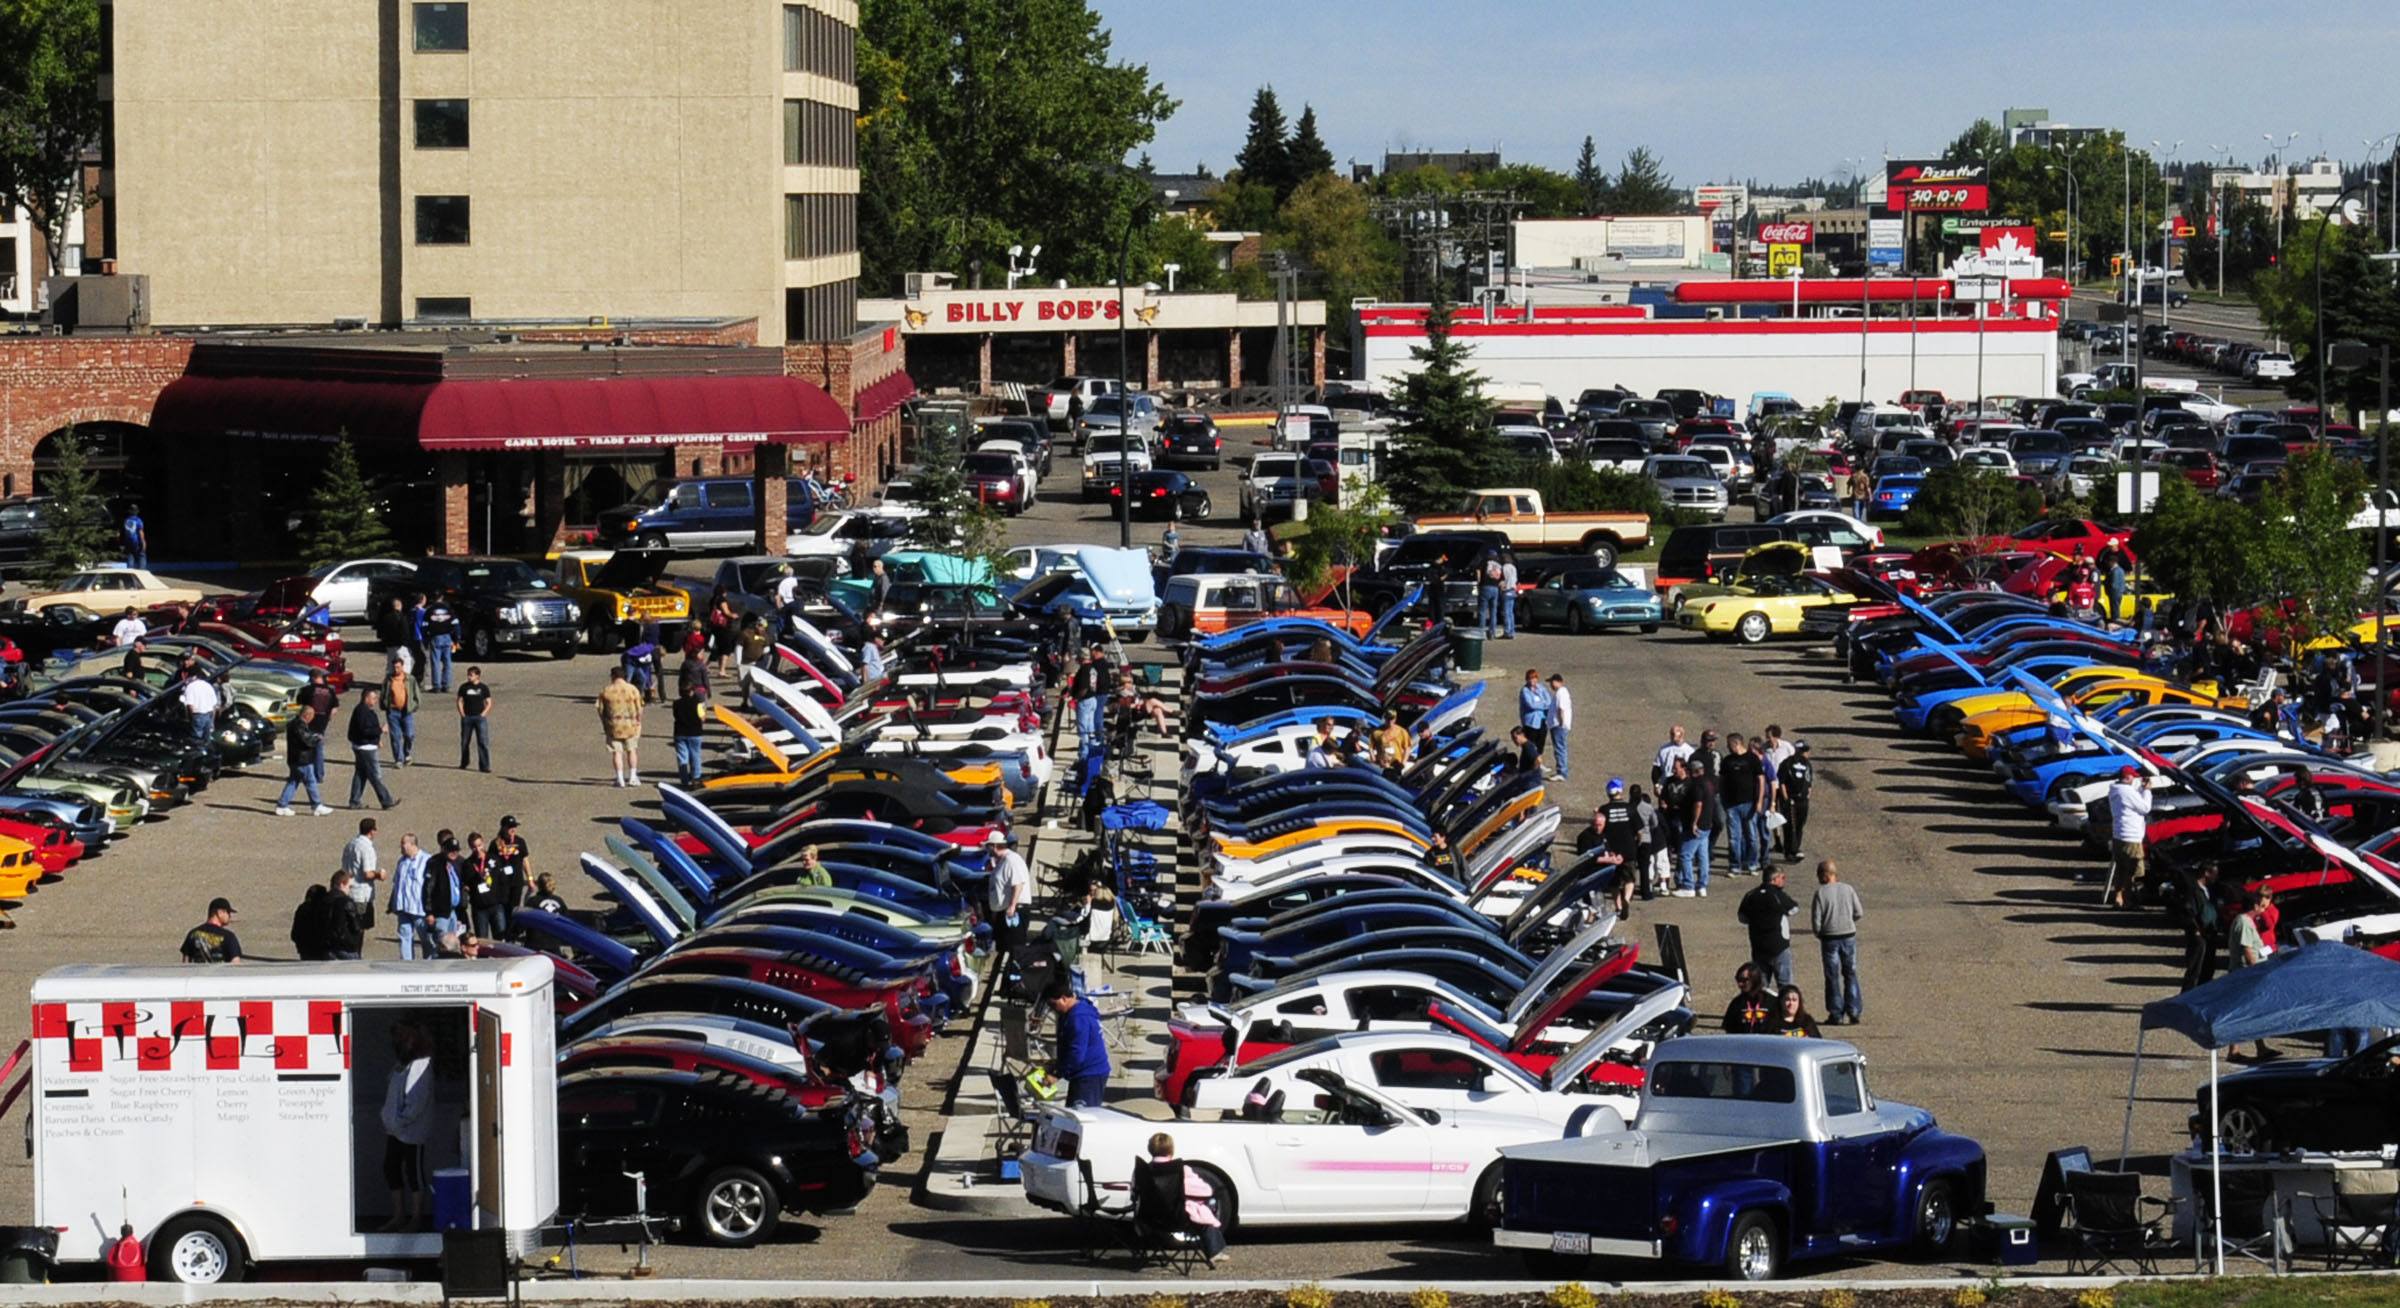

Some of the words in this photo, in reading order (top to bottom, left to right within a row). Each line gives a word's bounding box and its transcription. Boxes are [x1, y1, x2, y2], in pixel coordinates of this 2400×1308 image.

[1959, 218, 2021, 227] Enterprise
[947, 302, 1024, 322] BILLY
[1038, 300, 1121, 321] BOB'S
[504, 439, 539, 447] CAPRI
[542, 438, 577, 446] HOTEL
[589, 436, 625, 446] TRADE
[628, 436, 652, 445] AND
[655, 434, 723, 444] CONVENTION
[727, 433, 768, 443] CENTRE
[44, 1076, 100, 1086] Watermelon
[109, 1074, 137, 1085] Sugar
[139, 1074, 159, 1083] Free
[160, 1073, 211, 1084] Strawberry
[238, 1073, 271, 1083] Colada
[109, 1087, 137, 1098] Sugar
[139, 1087, 159, 1096] Free
[160, 1086, 192, 1097] Cherry
[216, 1087, 249, 1097] Lemon
[278, 1087, 307, 1096] Green
[309, 1086, 337, 1097] Apple
[110, 1101, 131, 1110] Blue
[133, 1100, 179, 1111] Raspberry
[216, 1099, 248, 1110] Cherry
[278, 1098, 325, 1109] Pineapple
[110, 1114, 143, 1123] Cotton
[143, 1113, 174, 1124] Candy
[216, 1112, 250, 1123] Mango
[278, 1111, 330, 1122] Strawberry
[45, 1128, 81, 1138] Peaches
[93, 1127, 125, 1137] Cream
